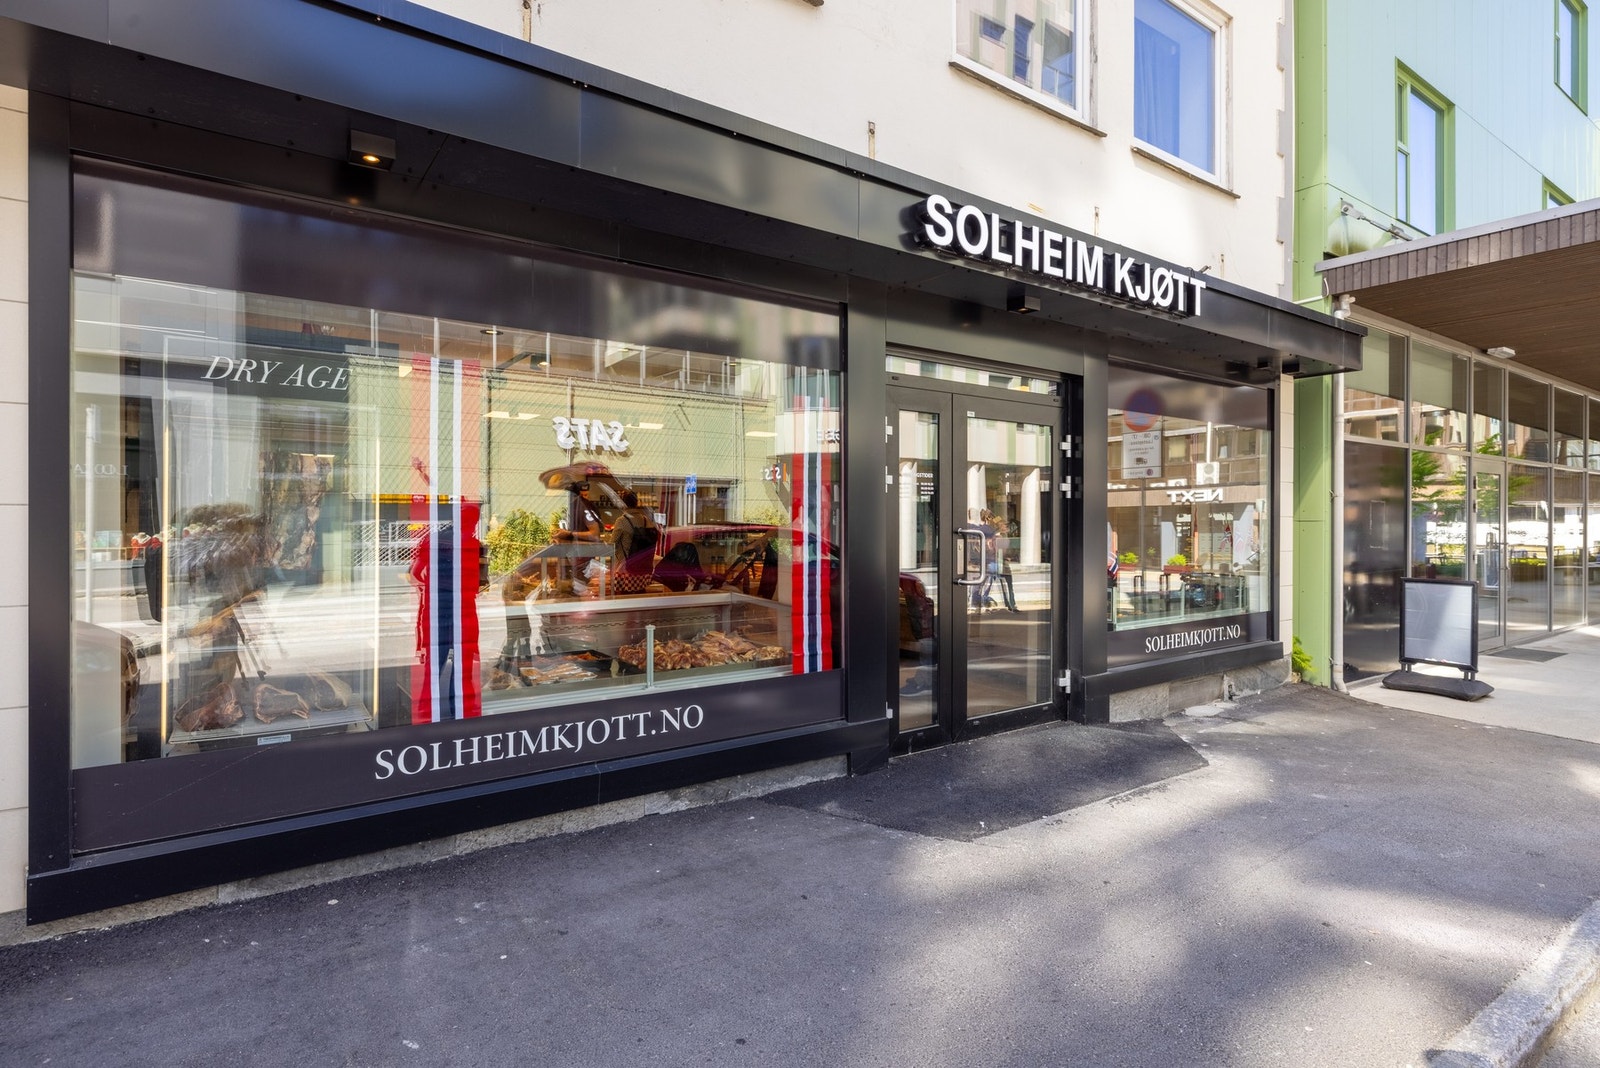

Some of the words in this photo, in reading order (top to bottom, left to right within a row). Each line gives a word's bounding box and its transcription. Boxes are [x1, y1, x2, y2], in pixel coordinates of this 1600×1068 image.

[925, 194, 1103, 288] SOLHEIM
[1114, 252, 1206, 316] KJØTT
[200, 355, 283, 384] DRY
[279, 364, 353, 391] AGE
[1145, 624, 1241, 654] SOLHEIMKJOTT.NO
[374, 704, 704, 780] SOLHEIMKJOTT.NO
